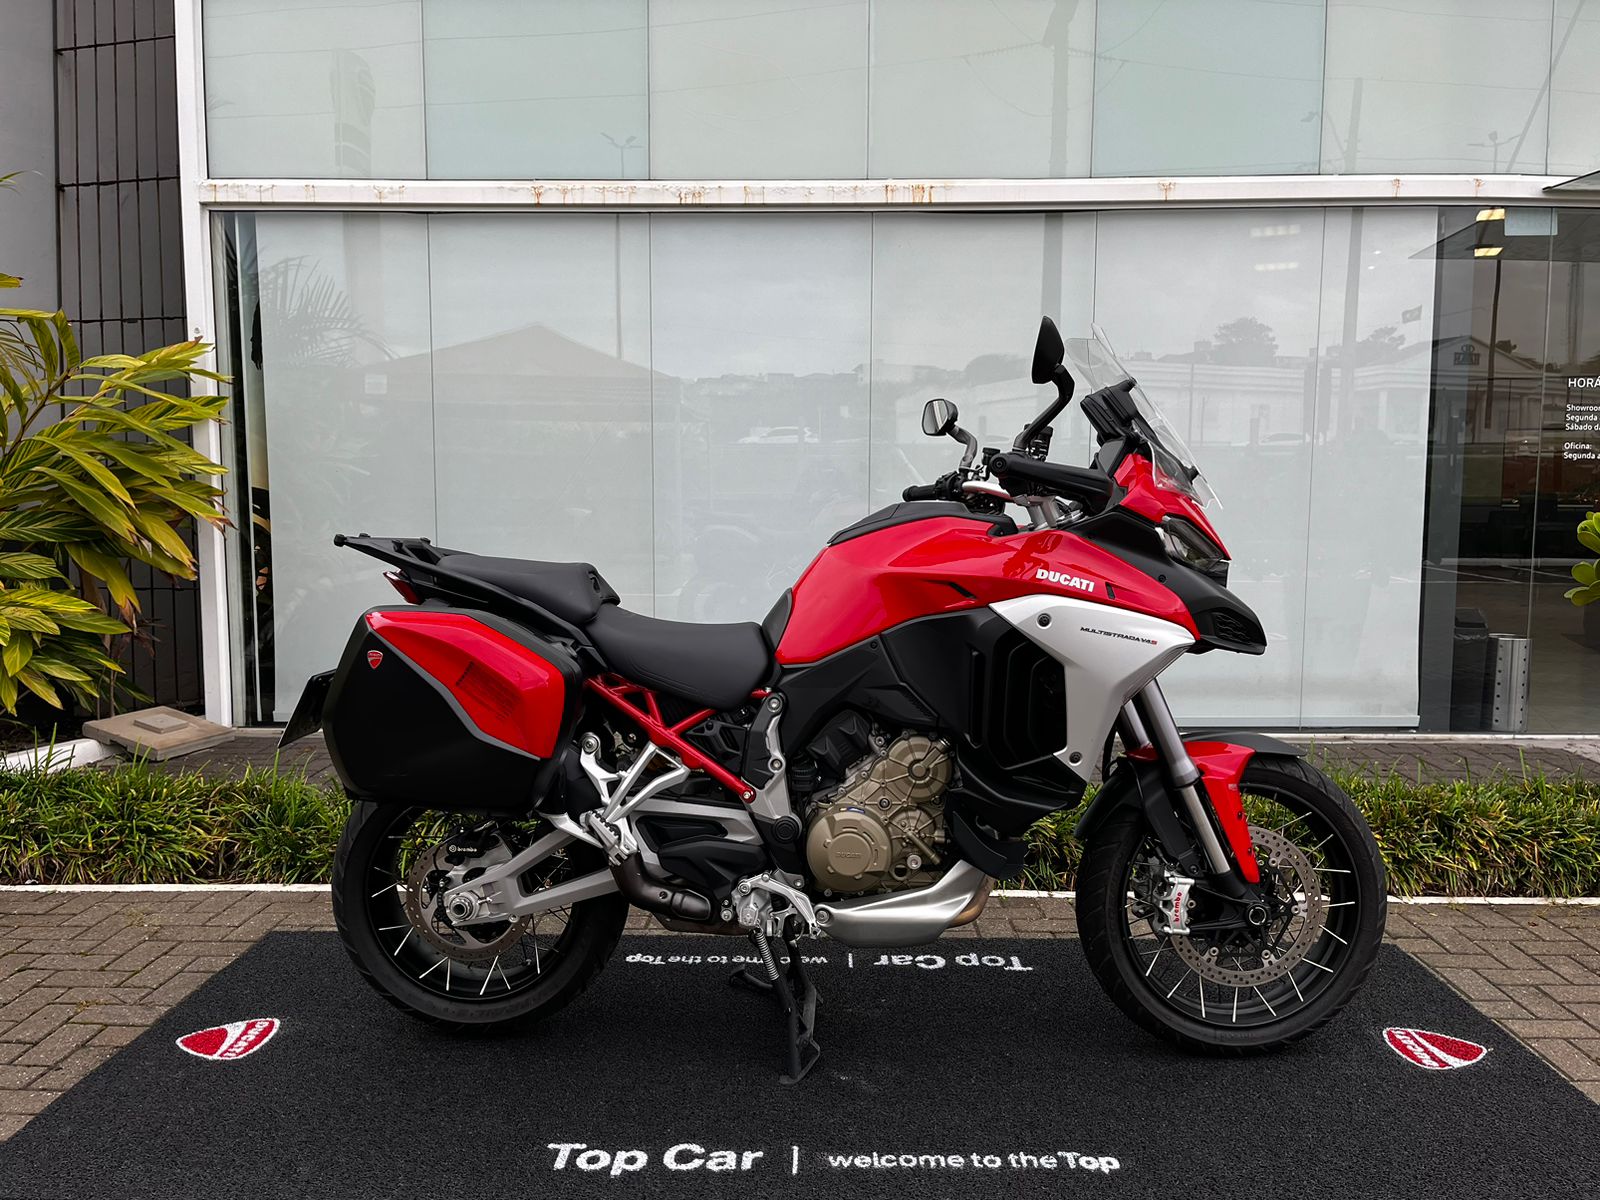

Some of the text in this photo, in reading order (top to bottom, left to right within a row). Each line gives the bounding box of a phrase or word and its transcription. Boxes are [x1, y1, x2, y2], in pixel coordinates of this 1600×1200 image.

[1566, 403, 1600, 412] Showroo
[1565, 413, 1598, 422] Segunda
[1565, 422, 1593, 431] Sábado
[1564, 441, 1592, 450] Oficina:
[1563, 451, 1596, 461] Segunda
[1036, 569, 1095, 593] DUCATI
[1080, 626, 1140, 642] MULTISTRADA
[1173, 891, 1183, 922] brembo
[625, 952, 1034, 971] Top Car wecme to the Top
[222, 1021, 270, 1058] DUCATI
[1390, 1028, 1441, 1067] DUCATI
[547, 1143, 1121, 1178] Top Car welcome to the Top
